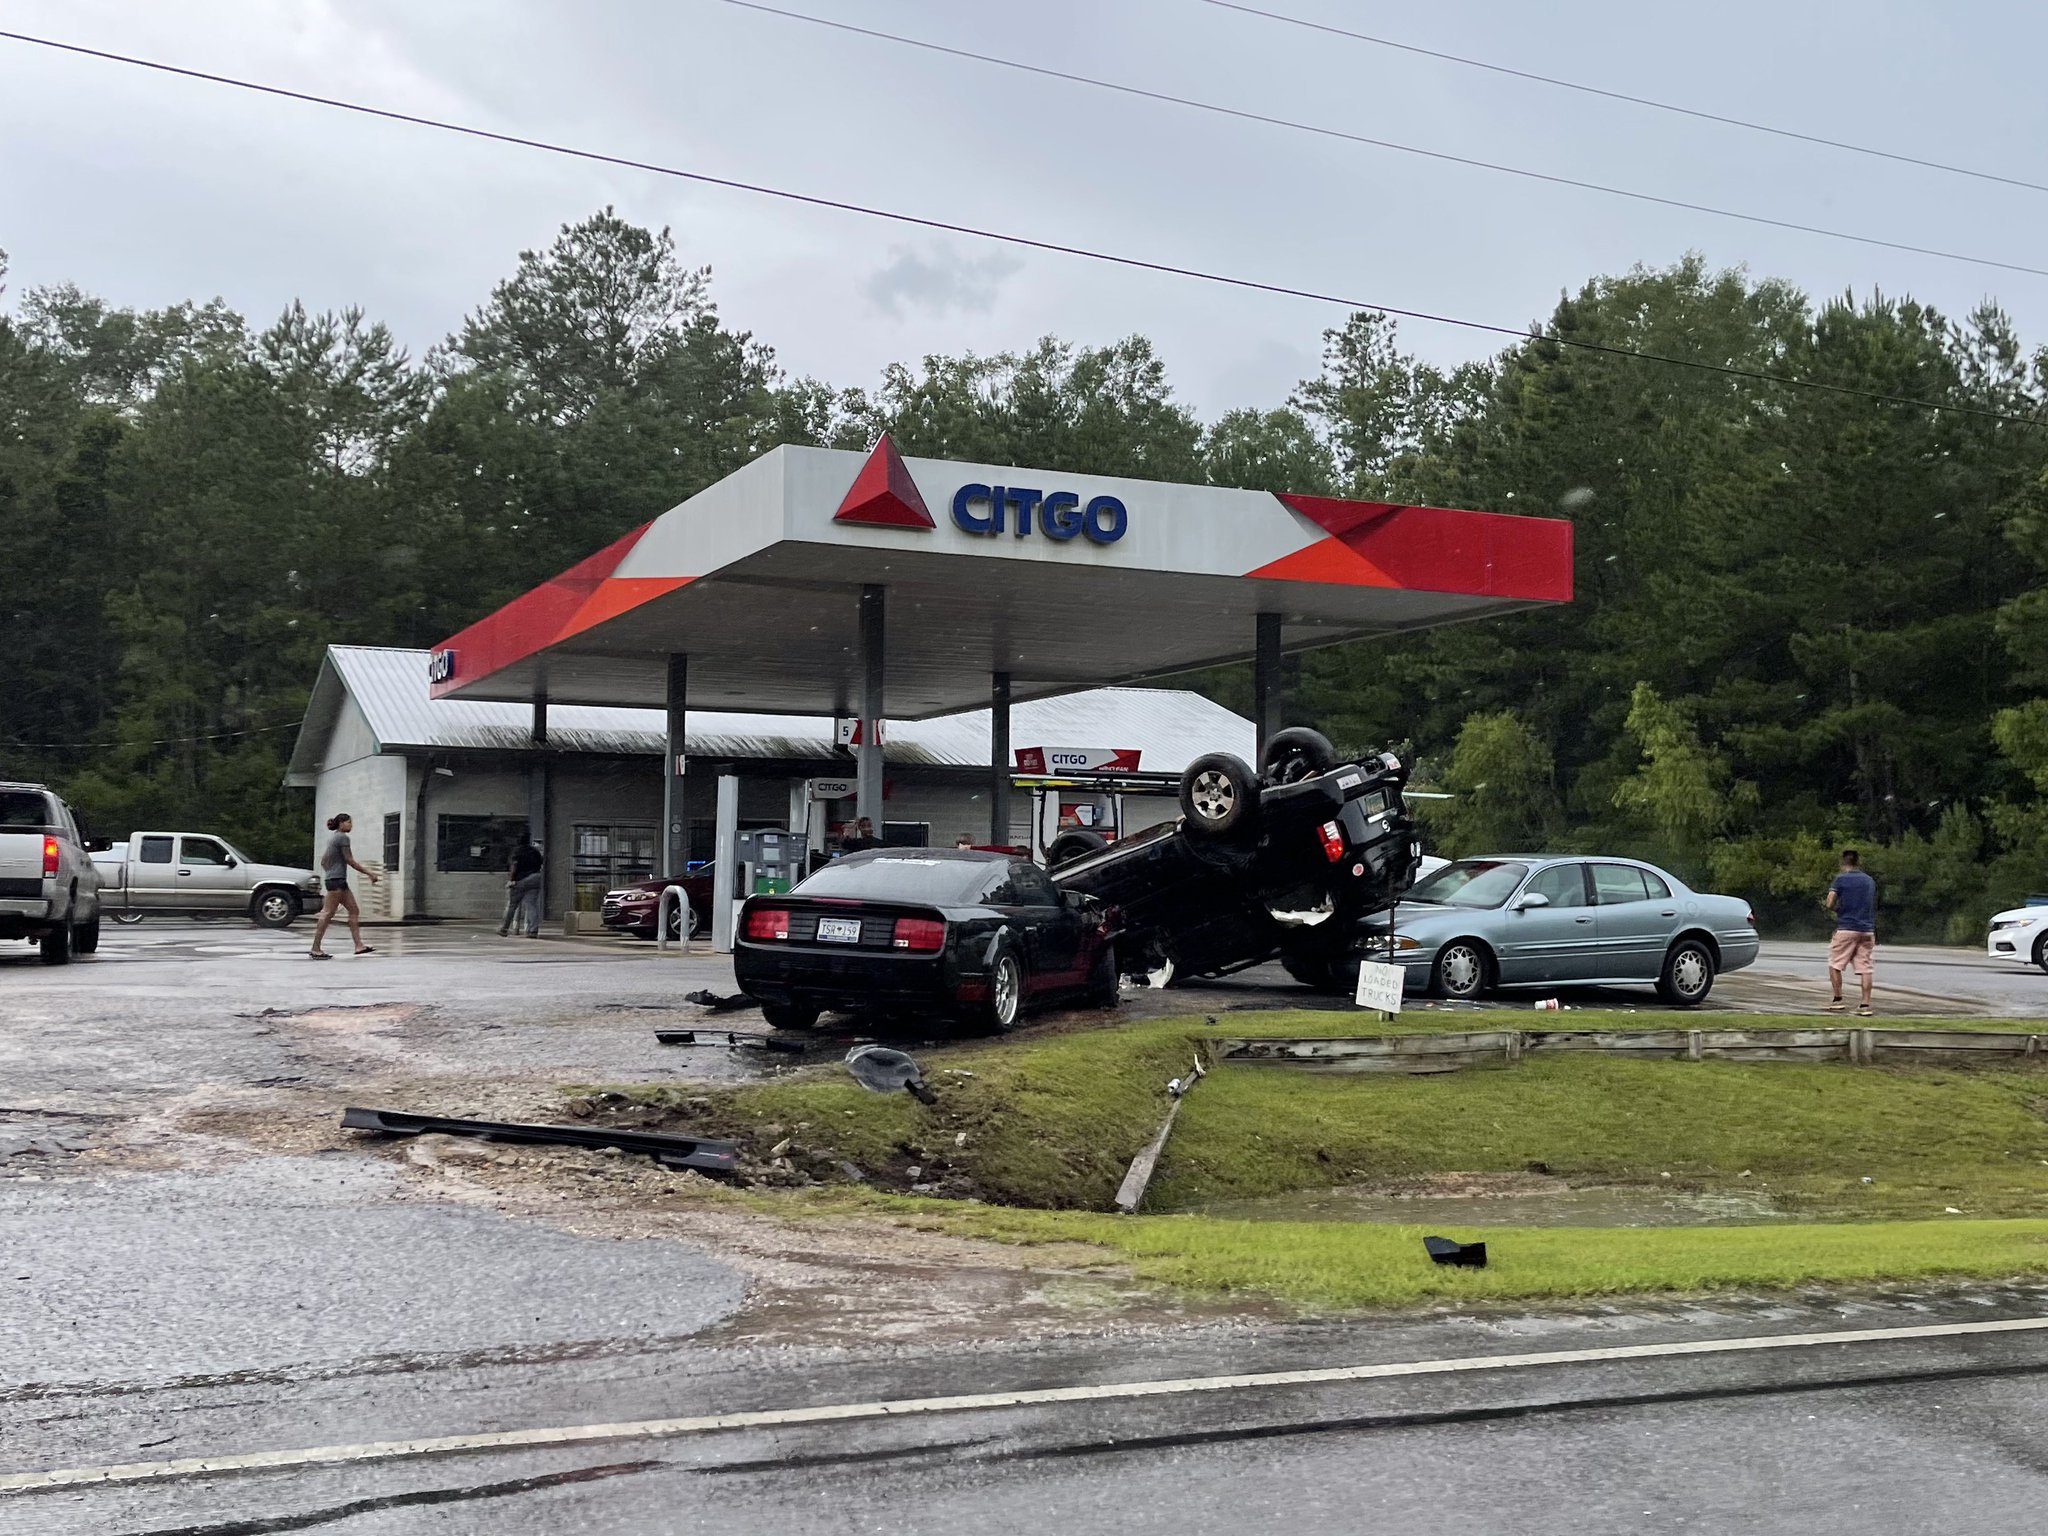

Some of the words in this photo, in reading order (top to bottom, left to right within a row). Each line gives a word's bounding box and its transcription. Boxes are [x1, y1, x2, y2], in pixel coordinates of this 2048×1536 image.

[951, 483, 1128, 544] CITGO
[843, 726, 849, 736] 5
[1051, 754, 1087, 765] CITGO
[818, 783, 847, 791] CITGO
[822, 924, 836, 935] TSR
[1375, 965, 1388, 976] NO
[1363, 975, 1398, 990] LOADED
[1361, 987, 1397, 1005] TRUCKS
